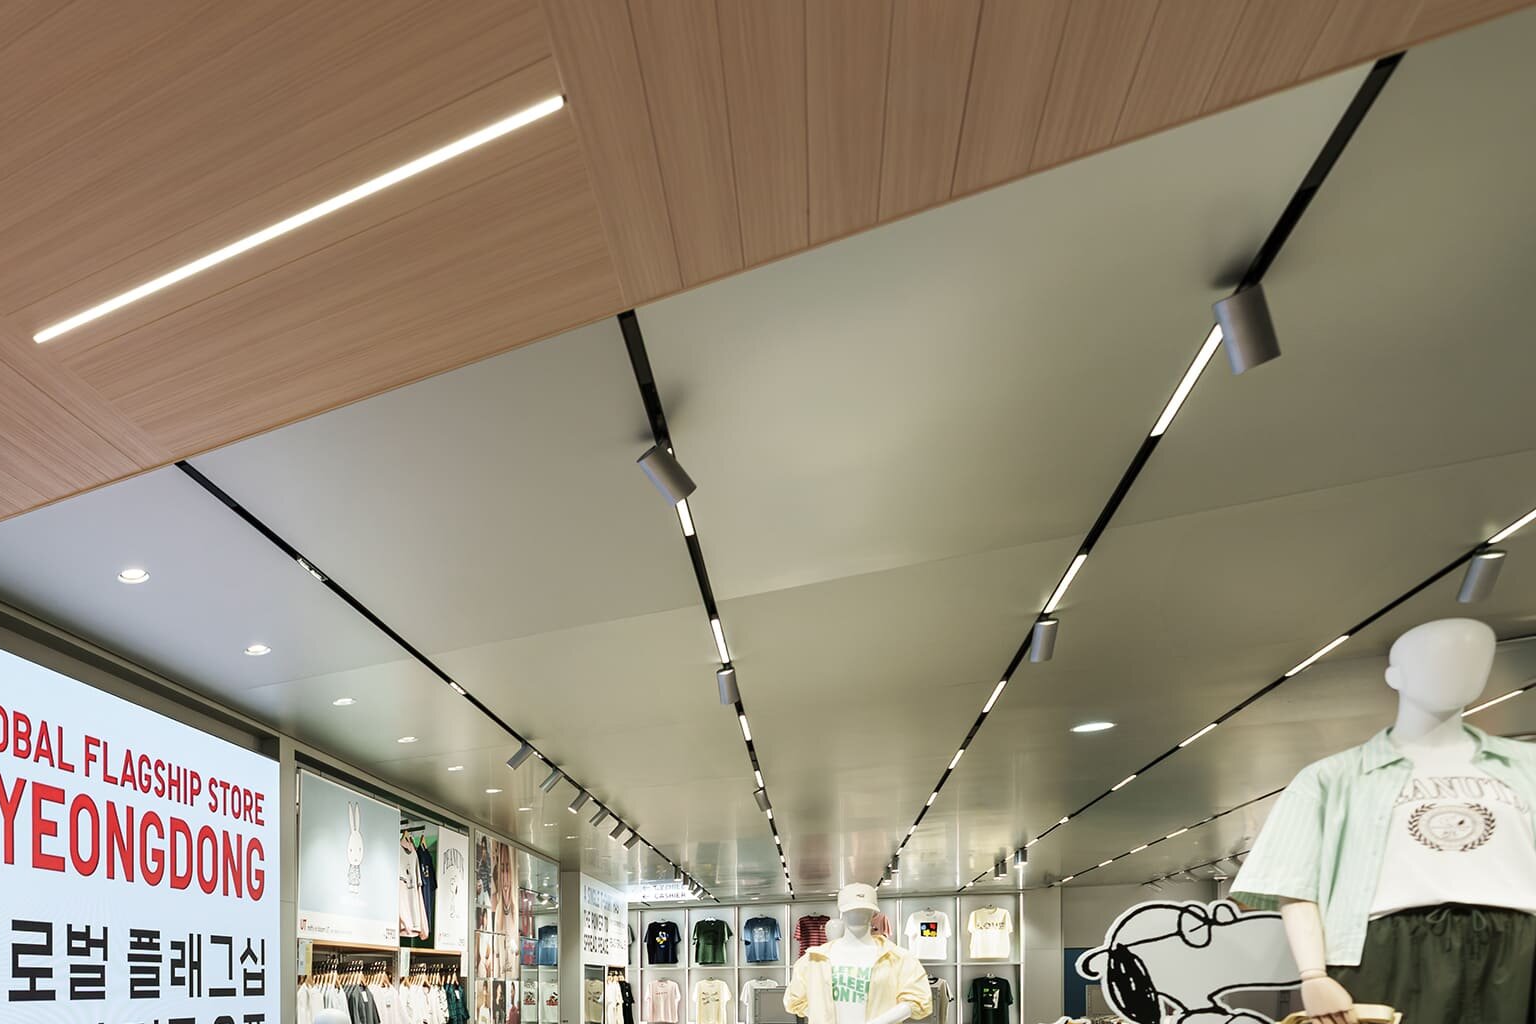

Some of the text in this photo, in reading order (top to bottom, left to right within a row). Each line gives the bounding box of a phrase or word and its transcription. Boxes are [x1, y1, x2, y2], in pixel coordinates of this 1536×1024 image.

[84, 735, 202, 807] FLAGSHIP
[208, 778, 265, 827] STORE
[127, 928, 265, 999] 플래그십
